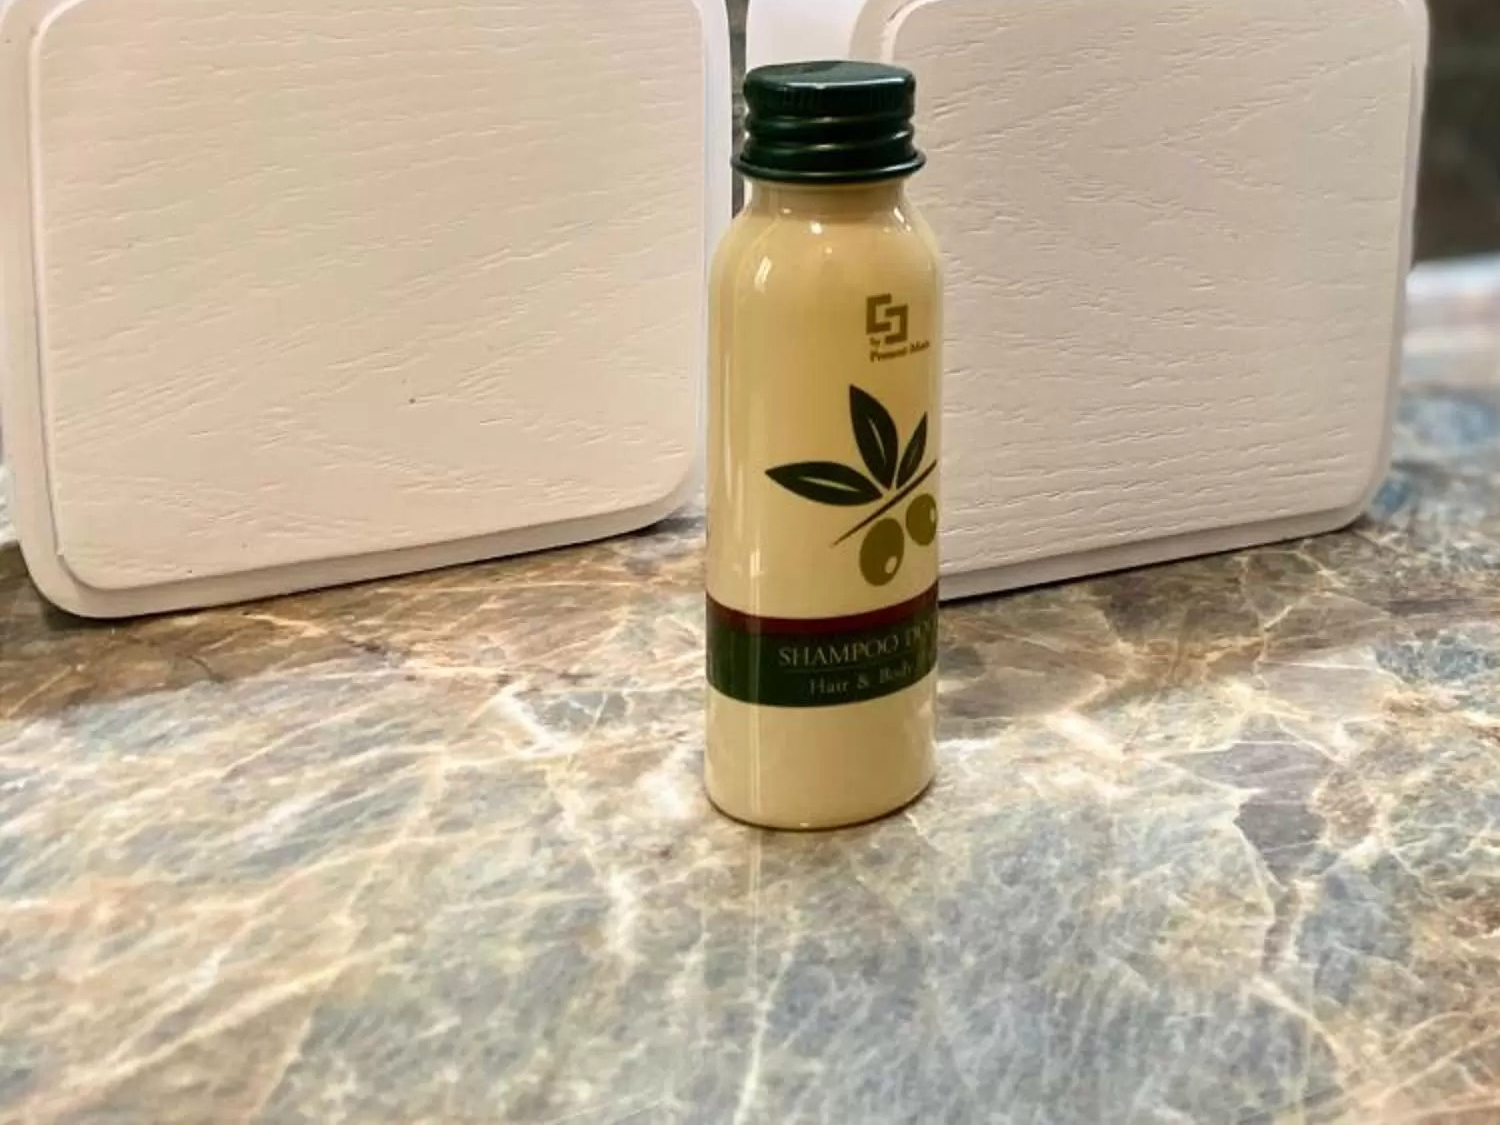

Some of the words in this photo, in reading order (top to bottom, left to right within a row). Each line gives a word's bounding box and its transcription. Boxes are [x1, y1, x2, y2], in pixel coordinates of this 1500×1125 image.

[777, 634, 900, 667] SHAMPOO
[808, 676, 849, 695] Hair
[857, 673, 870, 689] &
